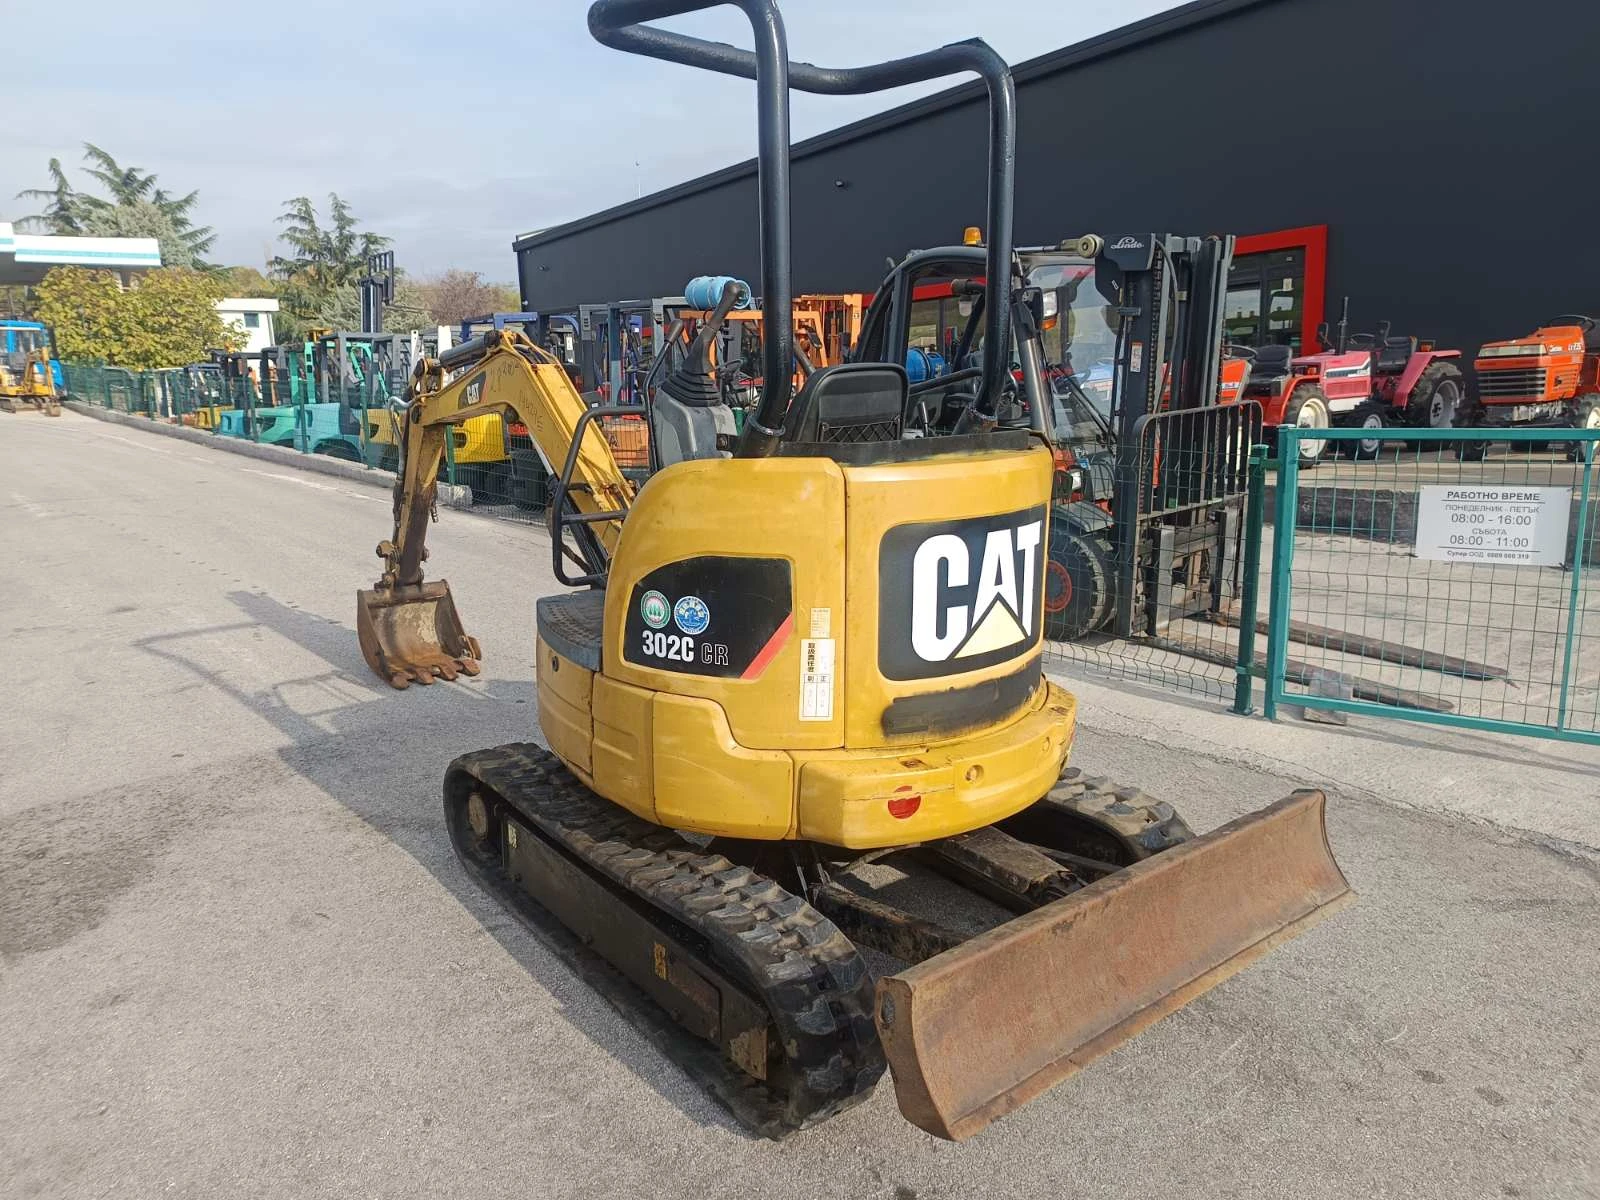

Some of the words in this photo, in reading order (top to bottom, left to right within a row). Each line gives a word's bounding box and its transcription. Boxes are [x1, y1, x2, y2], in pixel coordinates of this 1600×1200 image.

[1110, 236, 1144, 249] Linde
[466, 382, 480, 405] CAT
[1447, 491, 1498, 500] РАБОТНО
[1502, 492, 1541, 501] ВРЕМЕ
[1445, 504, 1503, 513] ПОНЕДЕЛНИК
[1451, 513, 1485, 524] 08:00
[1498, 515, 1532, 526] 16:00
[1472, 528, 1507, 536] СЪБОТА
[1450, 535, 1483, 546] 08:00
[1497, 537, 1529, 547] 11:00
[911, 520, 1042, 662] CAT
[642, 630, 695, 663] 302C
[701, 642, 729, 666] CR
